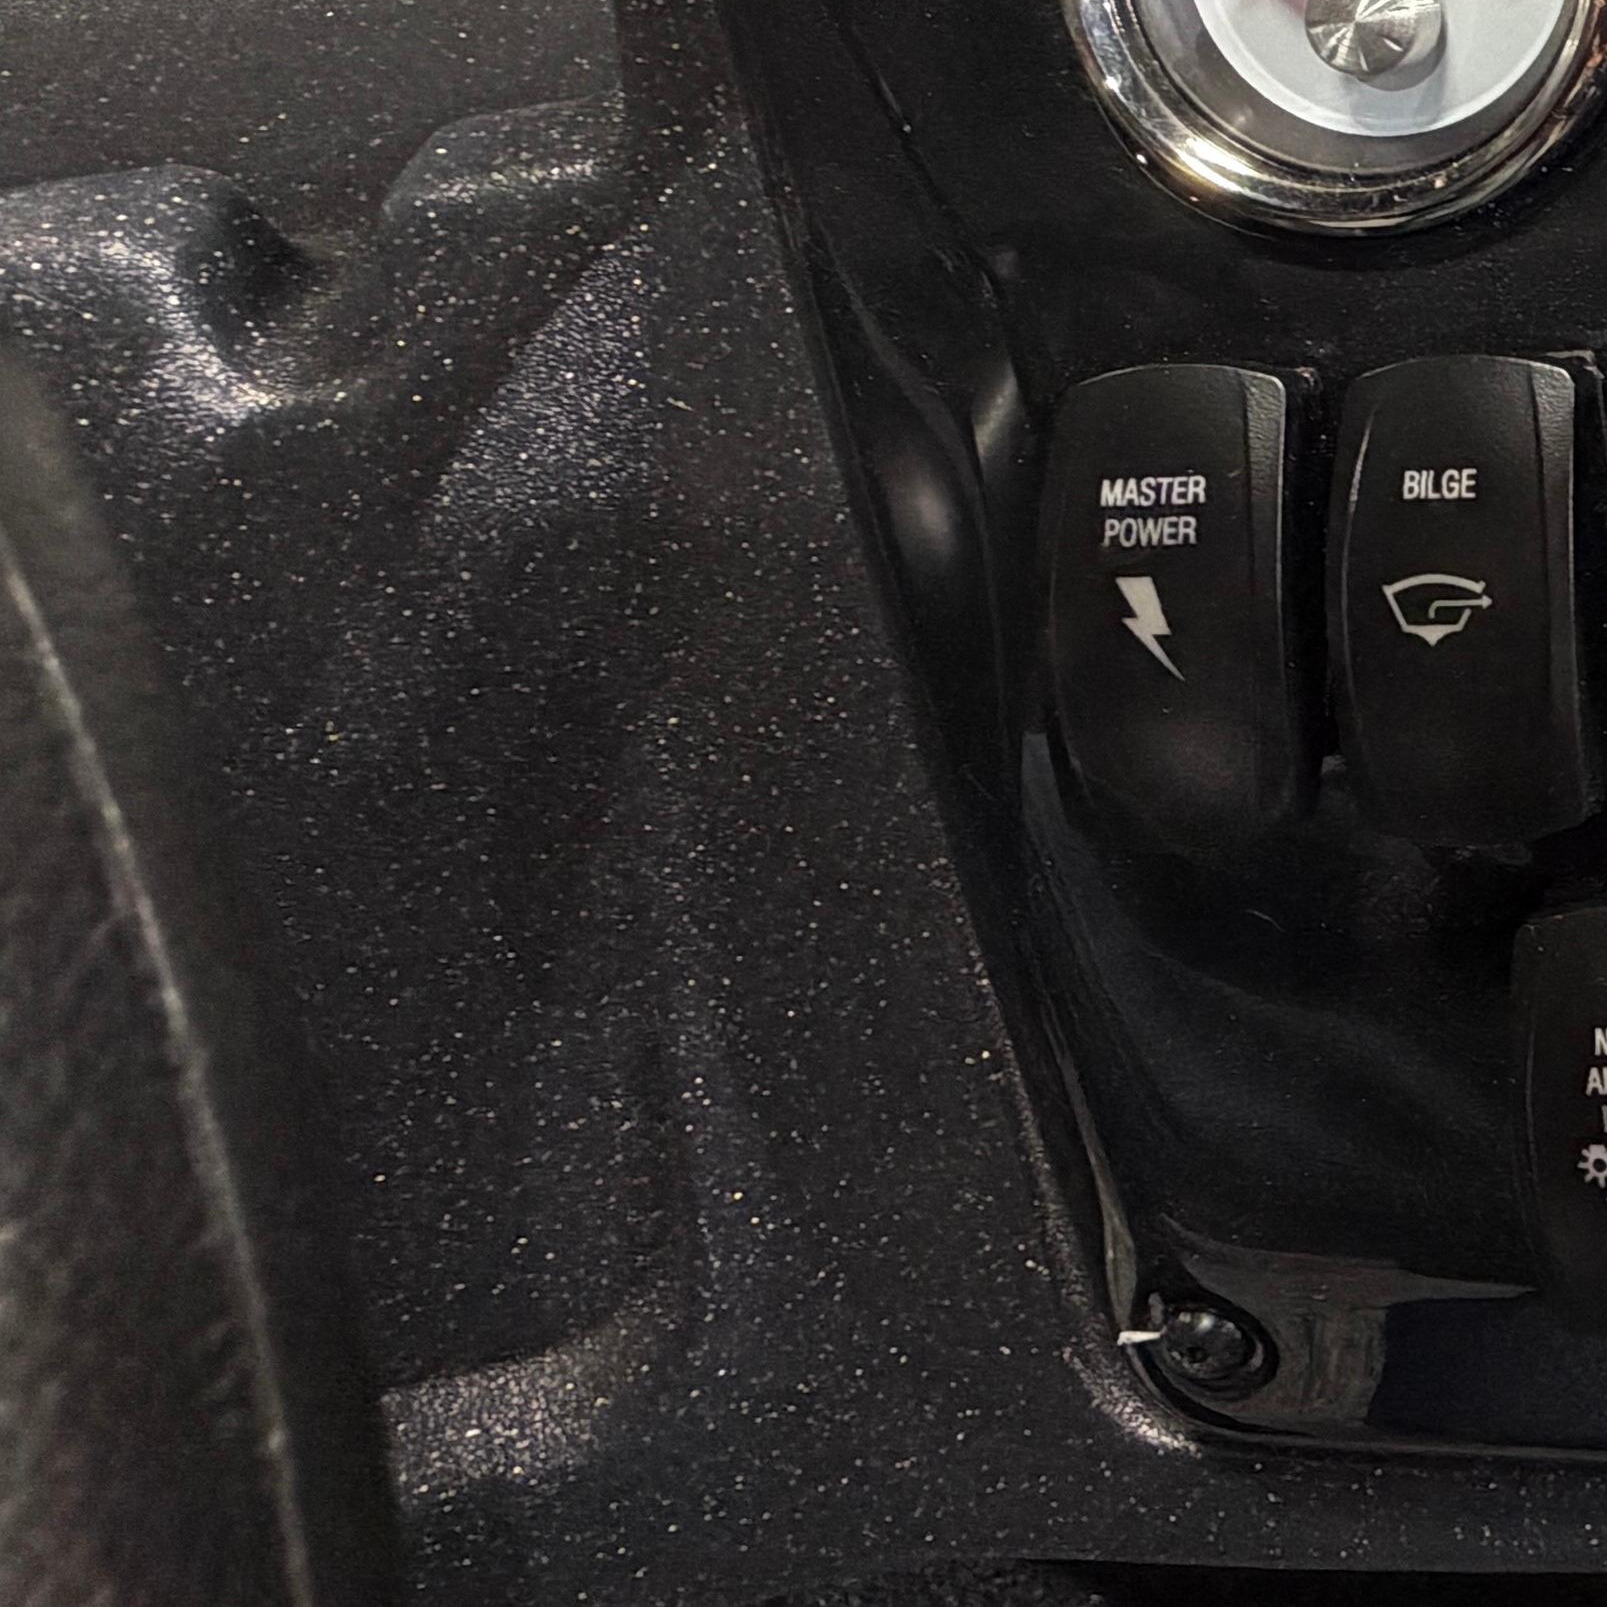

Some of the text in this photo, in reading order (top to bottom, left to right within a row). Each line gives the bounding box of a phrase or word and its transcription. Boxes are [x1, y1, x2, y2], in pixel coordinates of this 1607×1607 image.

[1101, 476, 1205, 506] MASTER
[1403, 469, 1476, 499] BILGE
[1104, 516, 1196, 547] POWER
